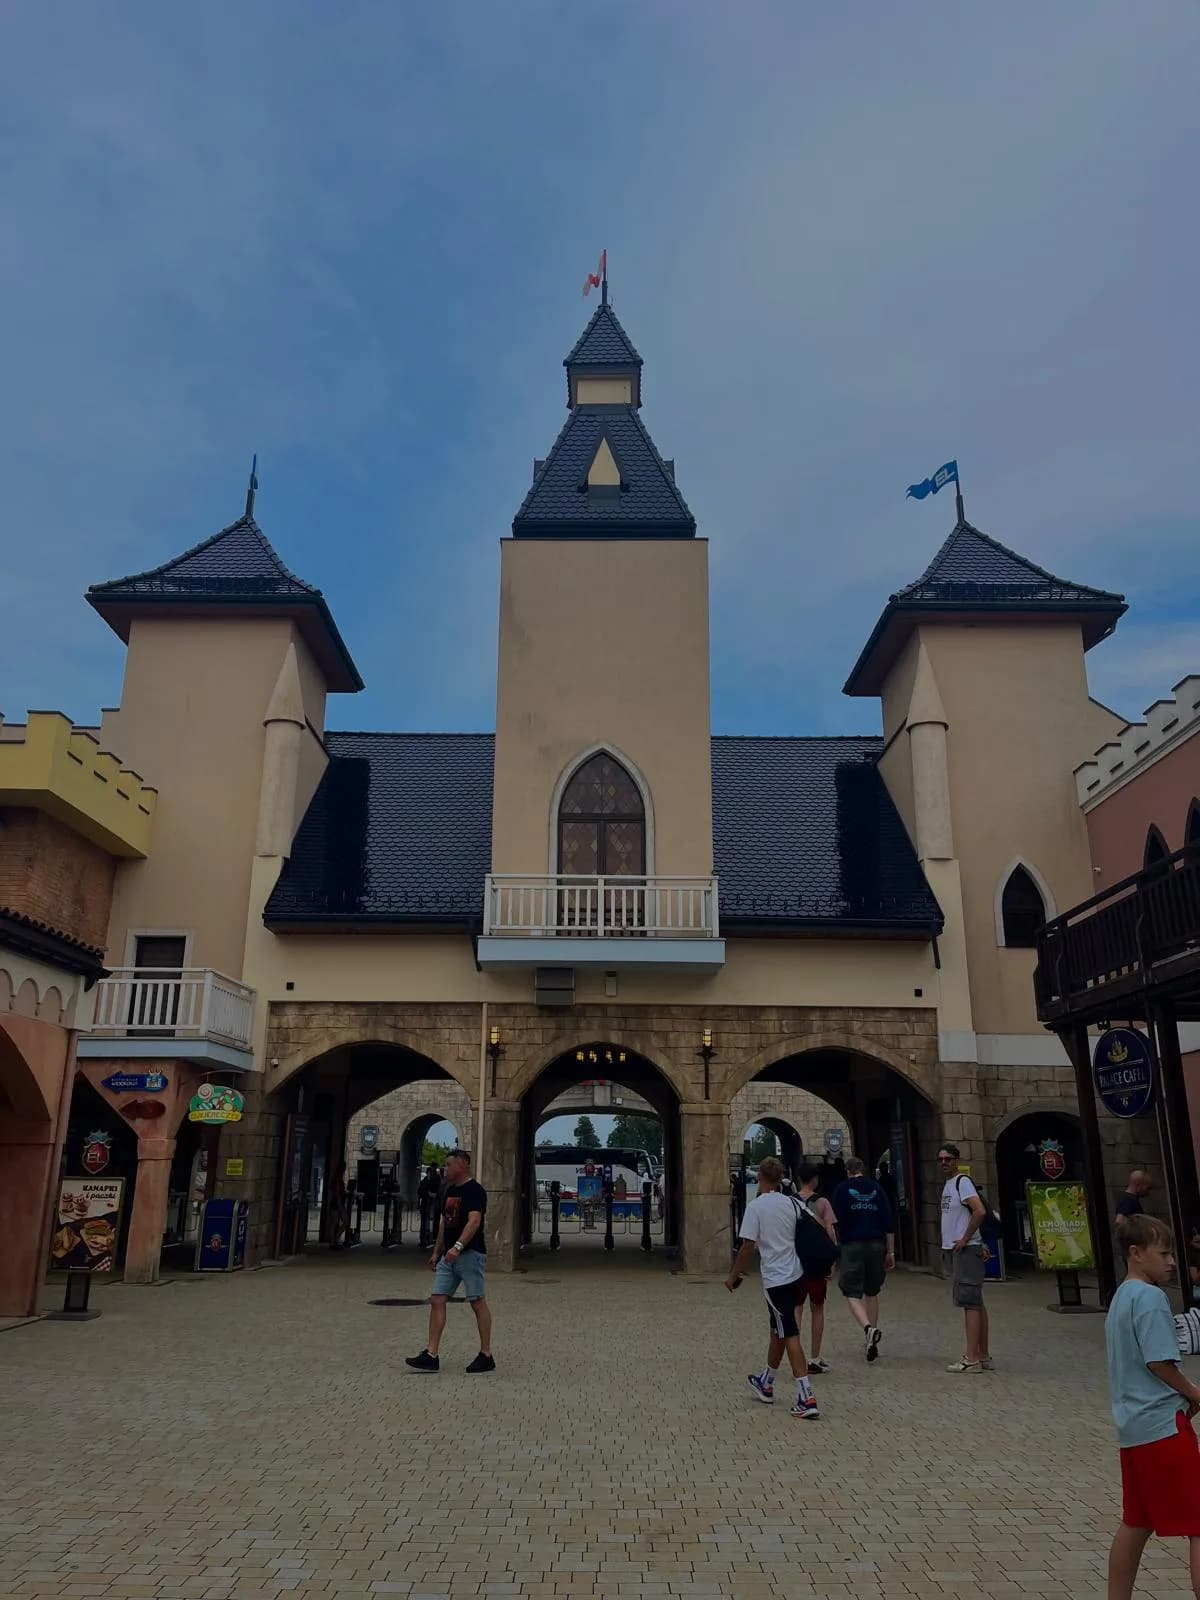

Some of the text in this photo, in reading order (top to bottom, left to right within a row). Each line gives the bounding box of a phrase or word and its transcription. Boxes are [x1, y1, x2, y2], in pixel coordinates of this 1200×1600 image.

[935, 467, 956, 488] EL
[87, 1153, 105, 1164] EL
[1044, 1159, 1062, 1170] EL
[82, 1184, 118, 1192] KANAPKI
[1038, 1220, 1087, 1228] LEMONIADA
